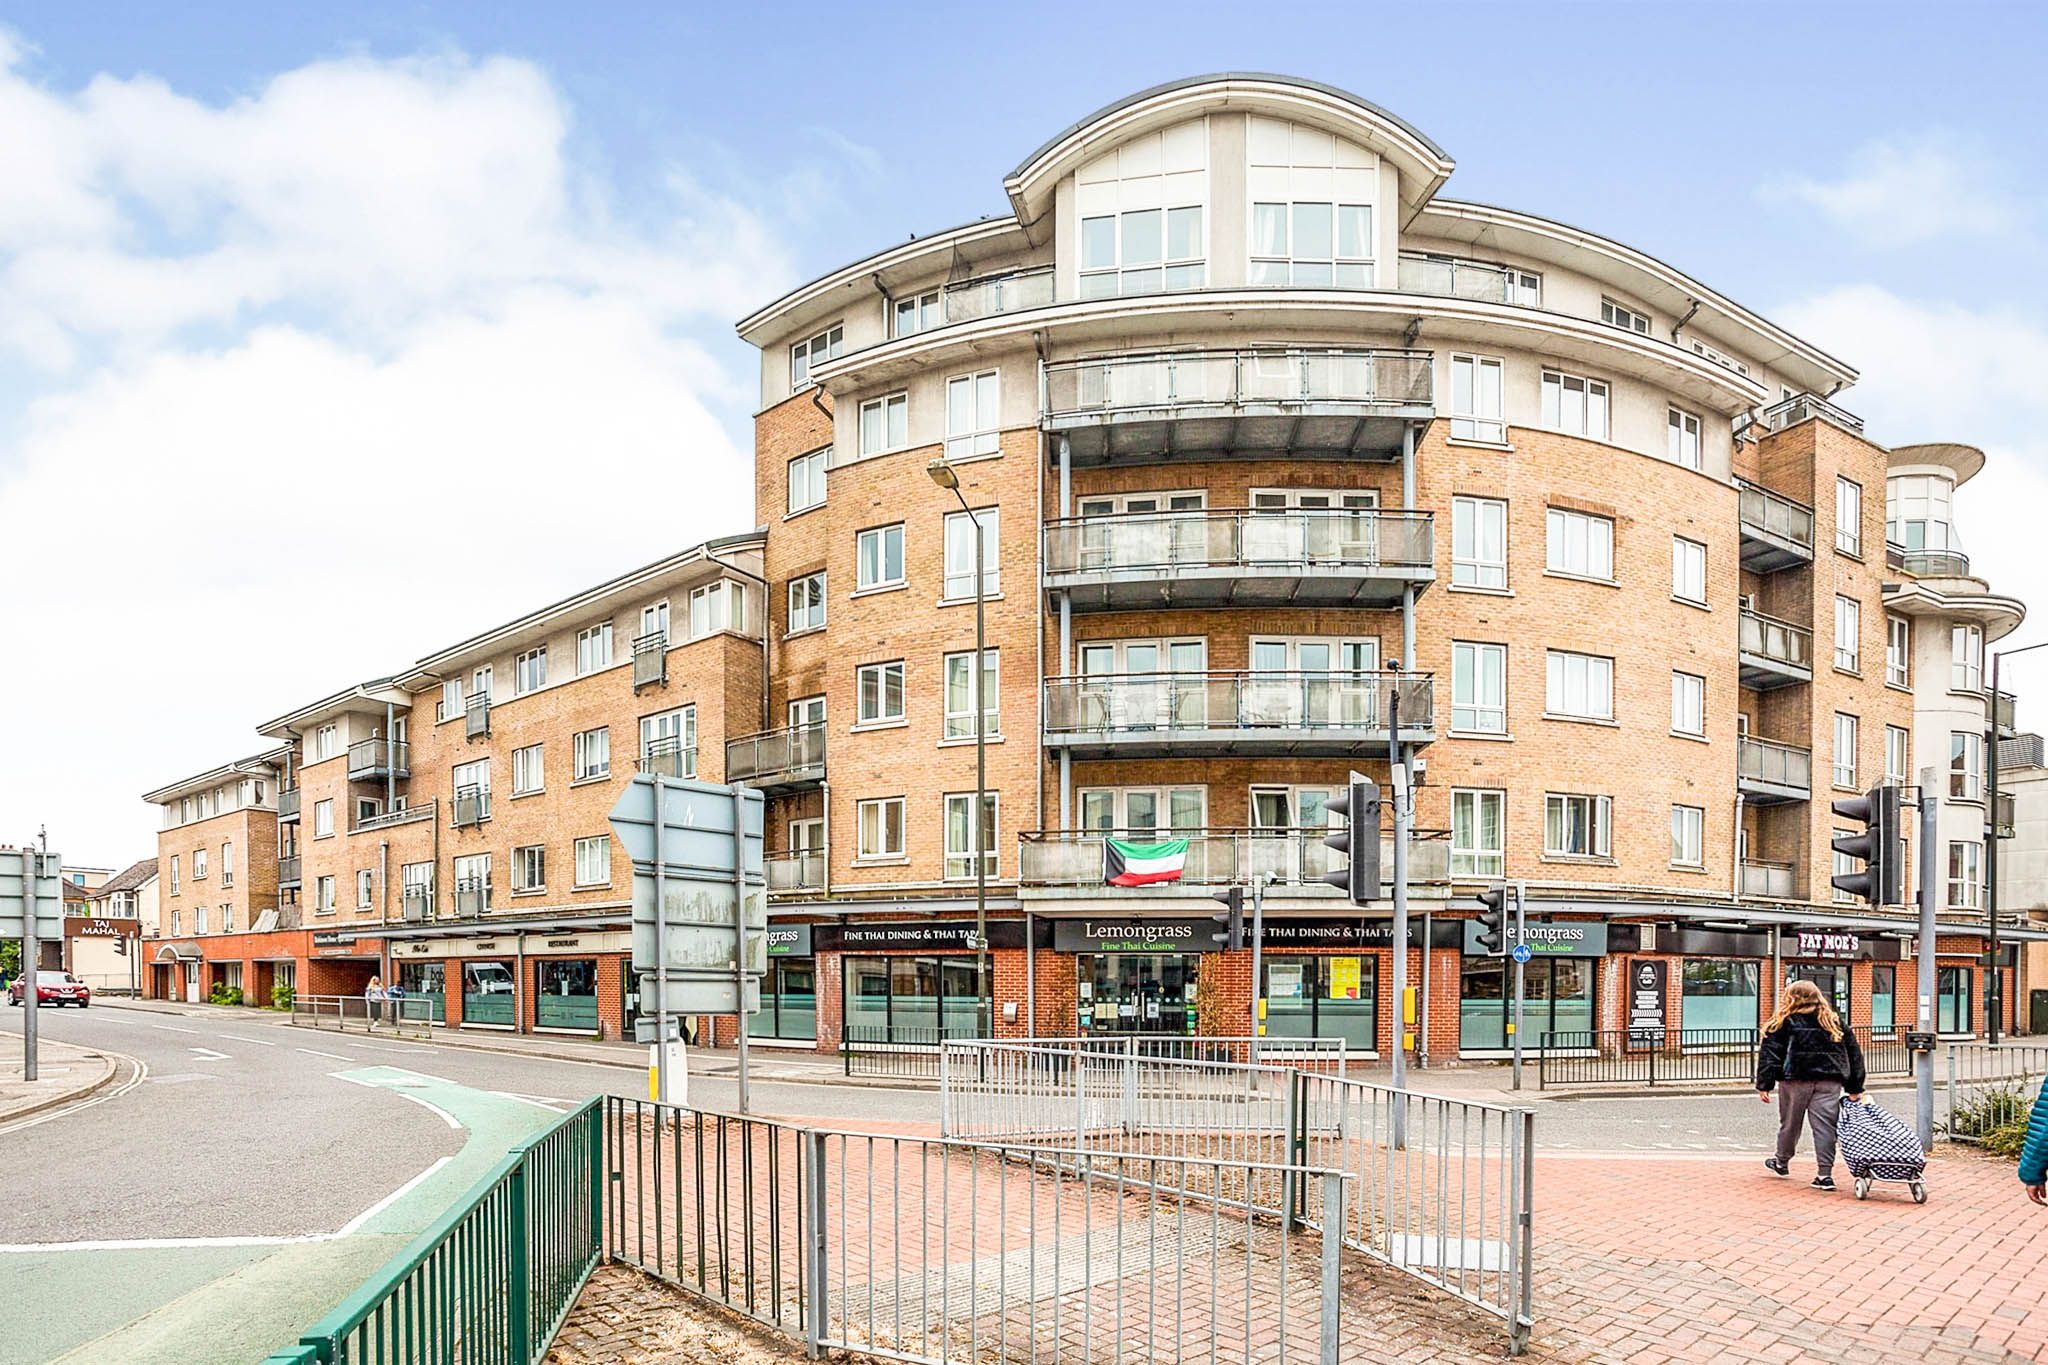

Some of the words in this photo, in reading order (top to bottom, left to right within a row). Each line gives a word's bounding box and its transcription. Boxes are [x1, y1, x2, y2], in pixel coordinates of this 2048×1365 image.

[94, 920, 109, 928] TAJ
[844, 931, 863, 940] FINE
[864, 931, 885, 940] THAI
[887, 930, 921, 940] DINING
[923, 930, 932, 939] &
[933, 930, 956, 939] THAI
[958, 930, 979, 939] TAP
[1085, 923, 1193, 942] Lemongrass
[1268, 928, 1296, 937] THAI
[1299, 928, 1341, 937] DINING
[1342, 927, 1353, 937] &
[1354, 928, 1380, 937] THAI
[1382, 928, 1413, 937] TAS
[1507, 927, 1584, 943] eongrass
[766, 931, 798, 946] ngrass
[1798, 933, 1822, 949] FAT
[1824, 933, 1859, 951] MOE'S
[1101, 942, 1120, 950] Fine
[1121, 942, 1141, 950] Thai
[1142, 942, 1176, 950] Cuisine
[1531, 943, 1546, 951] Thai
[1547, 943, 1575, 951] Cuisine
